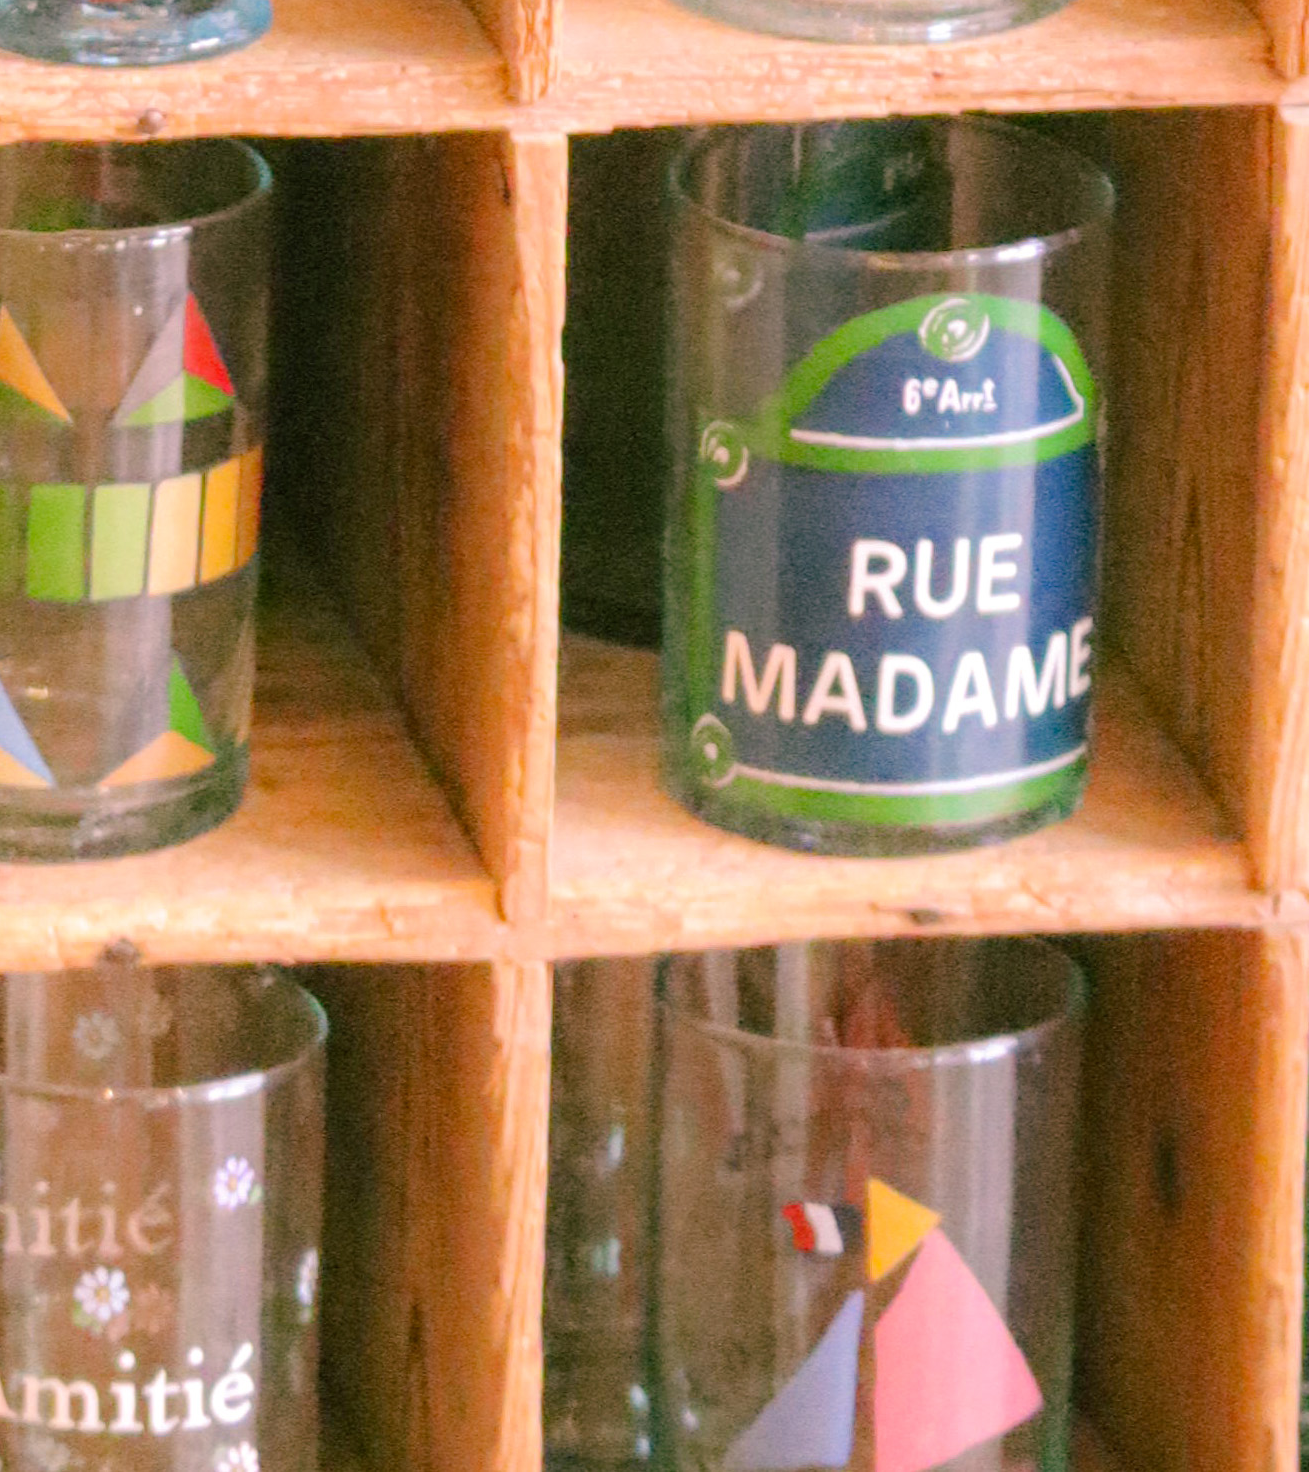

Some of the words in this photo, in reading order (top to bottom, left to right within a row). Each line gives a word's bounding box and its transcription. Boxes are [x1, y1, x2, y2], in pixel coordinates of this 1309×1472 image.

[937, 377, 999, 414] Arrt
[847, 532, 1024, 622] RUE
[720, 616, 1095, 737] MADAME
